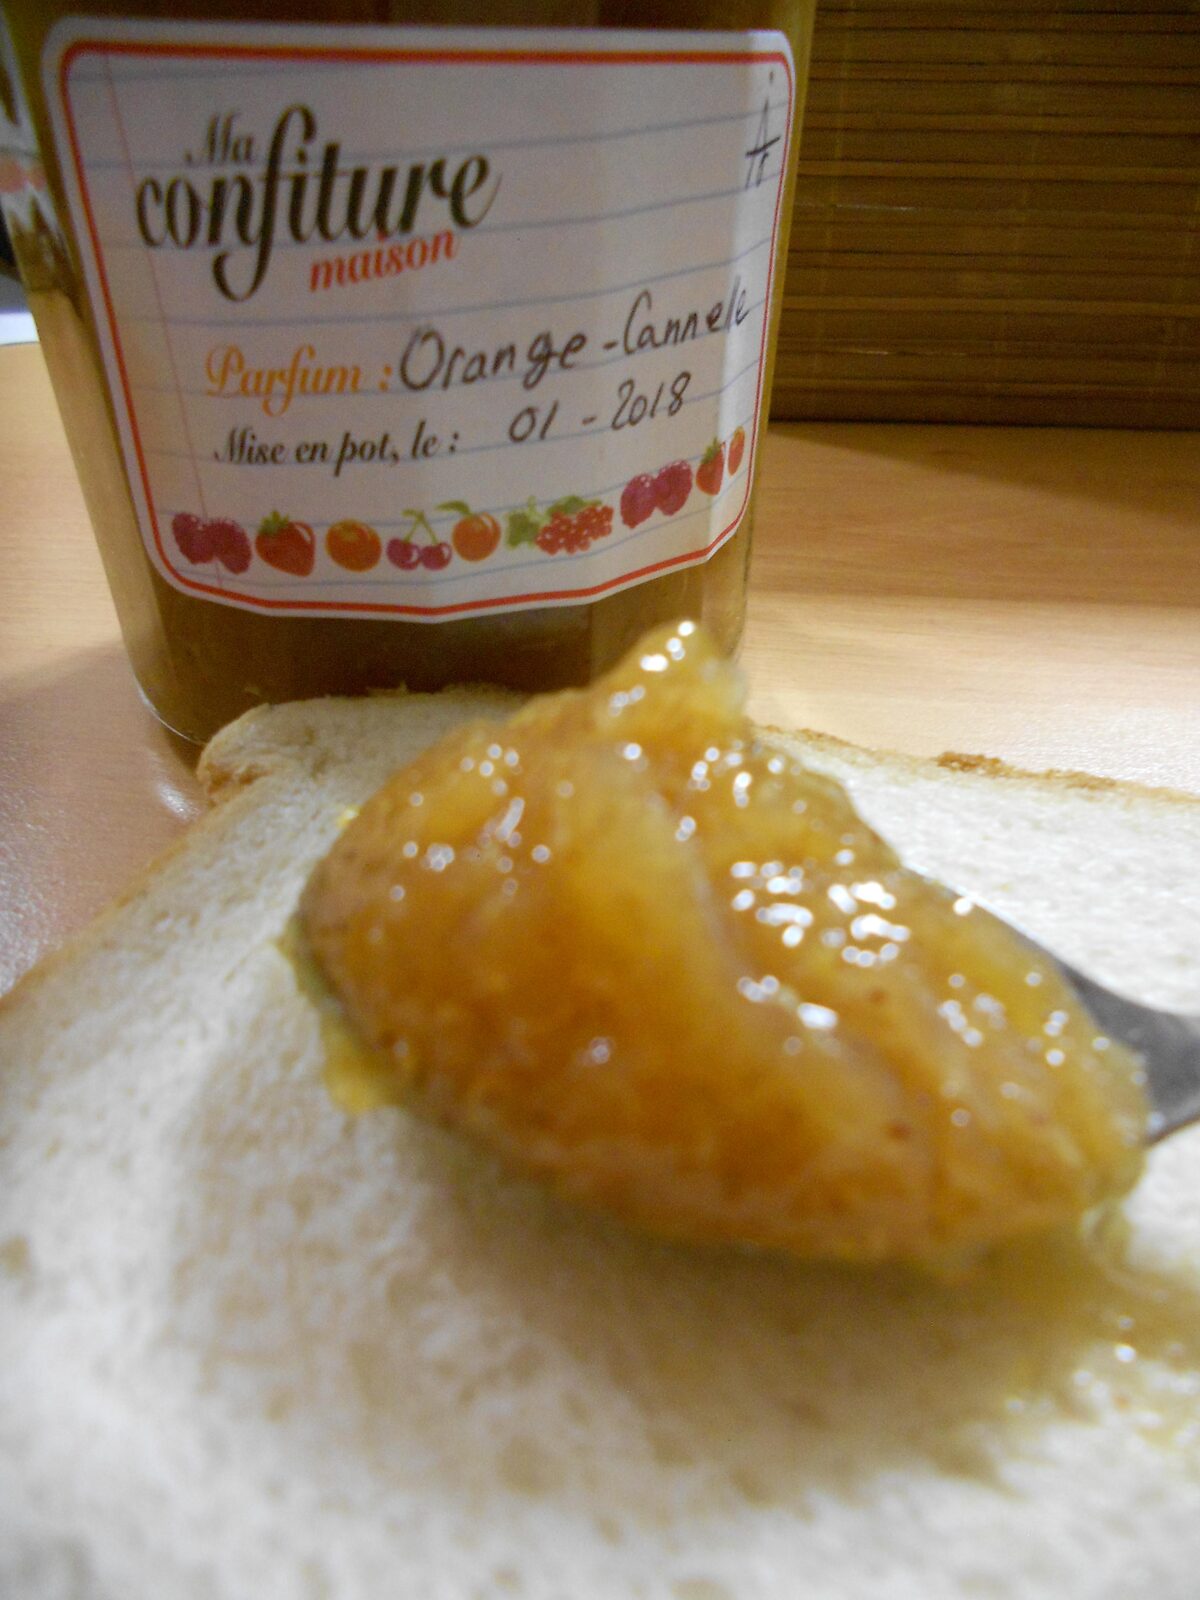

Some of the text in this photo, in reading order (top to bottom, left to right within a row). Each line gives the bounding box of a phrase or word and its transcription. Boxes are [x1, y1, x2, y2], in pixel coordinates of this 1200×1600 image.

[184, 111, 256, 166] Ma
[135, 102, 501, 301] confiture
[309, 228, 458, 292] maison
[204, 343, 362, 418] Parfum
[213, 425, 286, 466] Mise
[294, 440, 328, 464] en
[332, 430, 399, 478] pot,
[411, 418, 438, 461] le
[507, 400, 559, 444] 01
[610, 370, 692, 433] 2018
